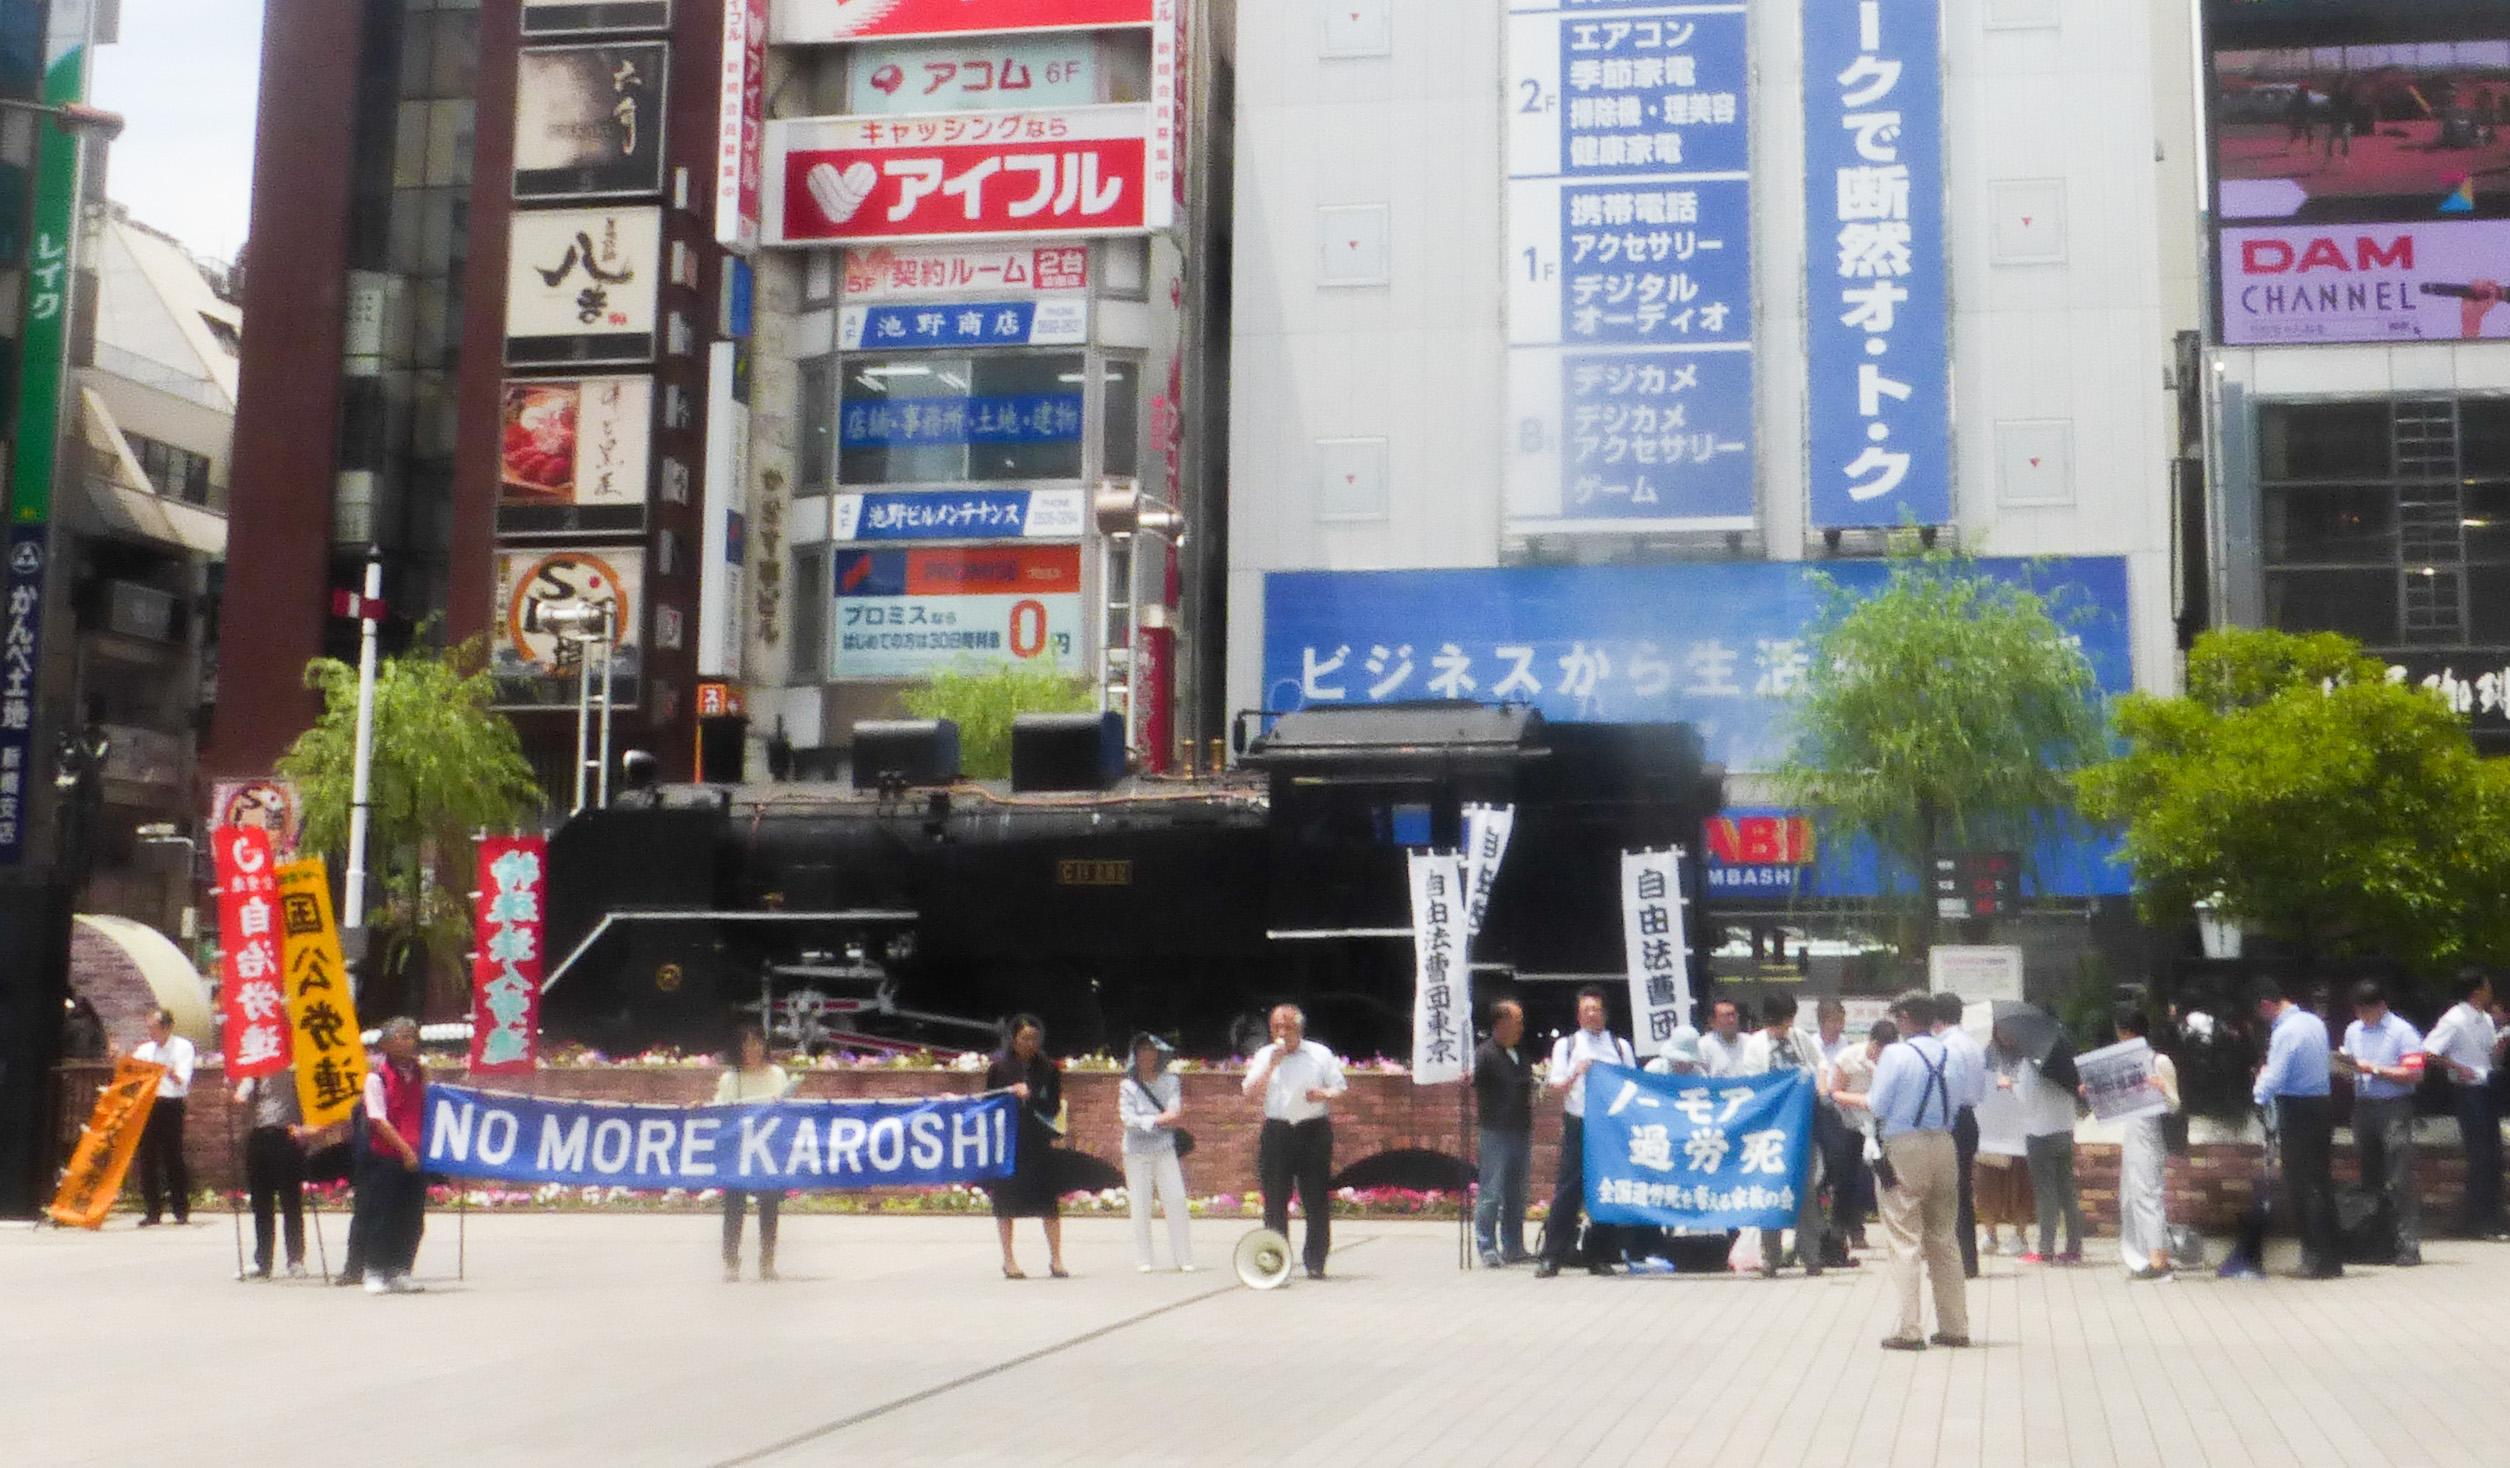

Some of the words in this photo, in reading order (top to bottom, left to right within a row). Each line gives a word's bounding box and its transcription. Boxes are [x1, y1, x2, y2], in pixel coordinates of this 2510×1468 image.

[1571, 21, 1695, 50] エアコン
[924, 58, 1031, 94] アコム
[1045, 60, 1080, 84] 6F
[1570, 55, 1696, 91] 季節家電
[1518, 78, 1557, 113] 2F
[861, 114, 1069, 145] キャッシングなら
[883, 152, 1123, 222] アイフル
[1571, 191, 1698, 226] 携帯電話
[1524, 246, 1554, 281] 1F
[1572, 231, 1723, 264] アクセサリー
[2241, 235, 2416, 275] DAM
[31, 233, 64, 320] レイク
[893, 255, 1027, 288] 契約ルーム
[1572, 272, 1699, 304] デジタル
[2241, 282, 2417, 314] CHANNEL
[877, 309, 1021, 338] 池野商店
[1572, 302, 1729, 335] オーディオ
[1574, 364, 1697, 396] デジカメ
[1575, 403, 1686, 434] デジカメ
[1575, 434, 1746, 464] アクセサリー
[1574, 475, 1659, 504] ゲーム
[868, 500, 1020, 529] 池野ビルメンテナンス
[1637, 867, 1679, 1044] 自由法曹団
[1607, 1080, 1755, 1125] ノーモア
[429, 1099, 518, 1166] NO
[536, 1113, 721, 1177] MORE
[738, 1107, 1005, 1176] KAROSHI
[1628, 1124, 1787, 1175] 過労死
